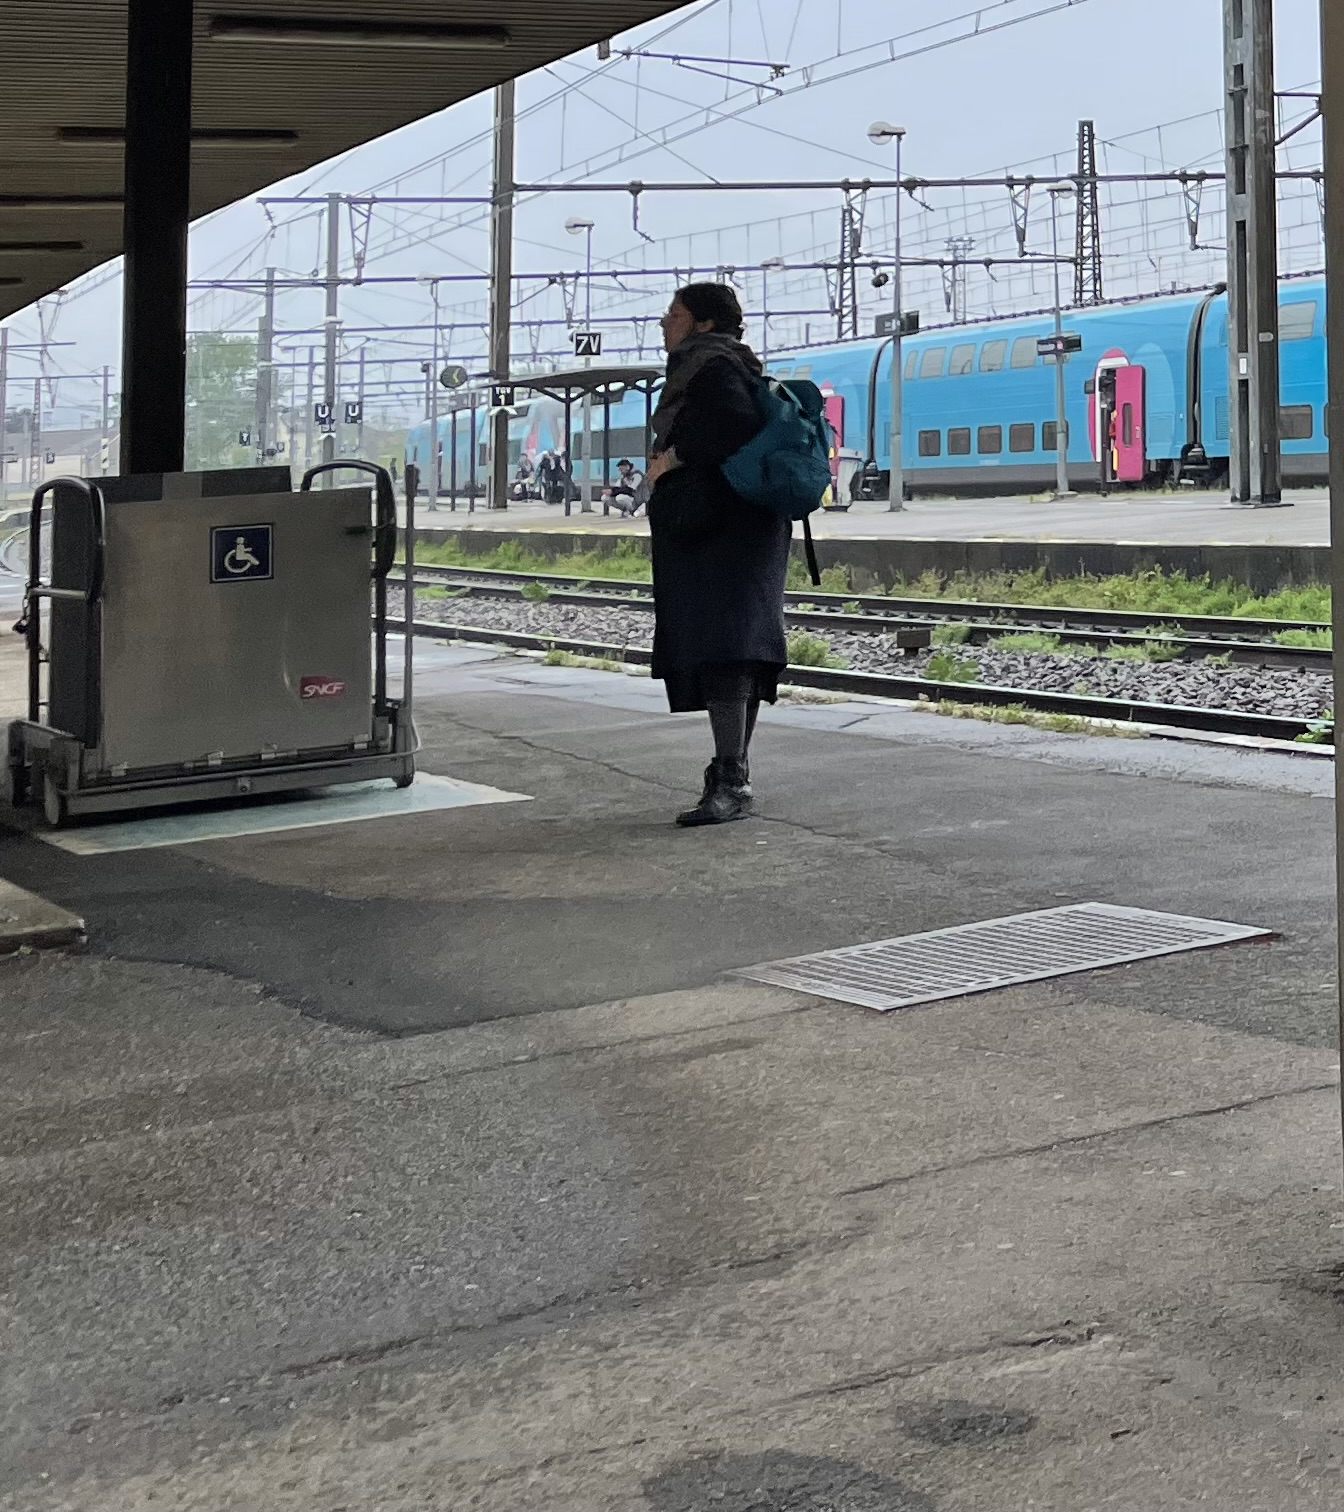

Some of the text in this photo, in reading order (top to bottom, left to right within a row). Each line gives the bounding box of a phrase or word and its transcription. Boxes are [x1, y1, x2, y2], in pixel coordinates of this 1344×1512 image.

[576, 335, 600, 353] 7V
[317, 404, 329, 418] U
[348, 404, 360, 417] U
[302, 681, 345, 697] SNCF
